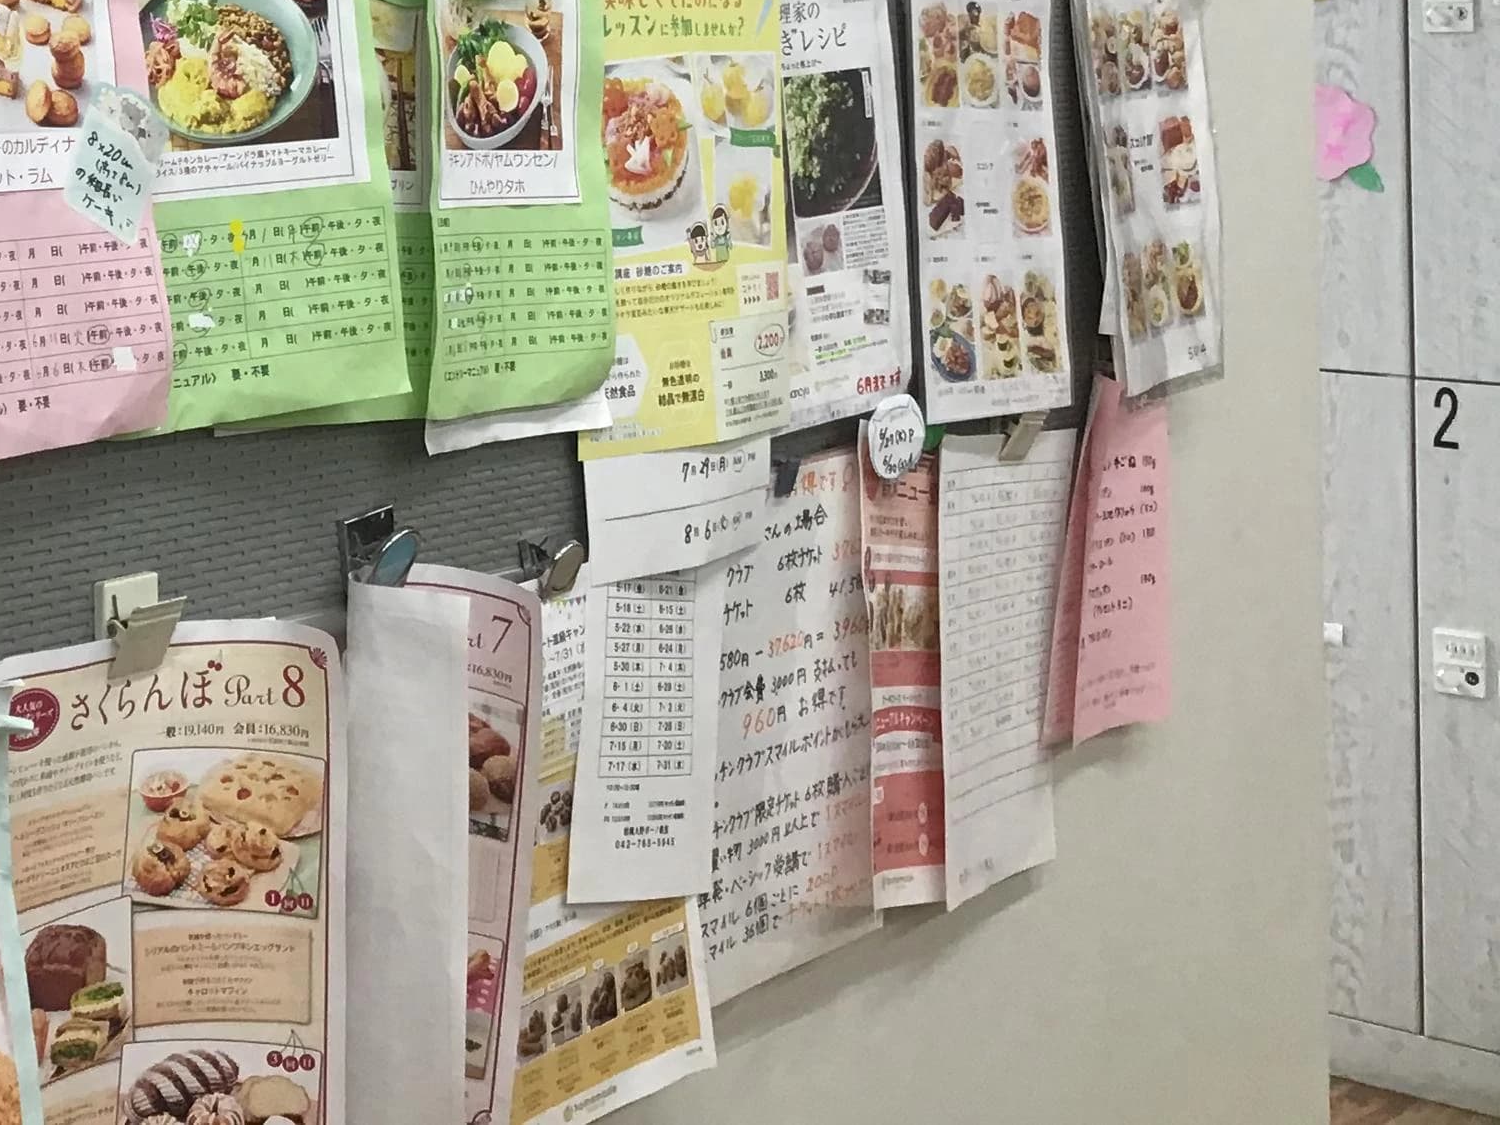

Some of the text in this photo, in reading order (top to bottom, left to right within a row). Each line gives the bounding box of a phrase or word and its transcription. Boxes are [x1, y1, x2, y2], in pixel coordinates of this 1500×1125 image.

[1433, 387, 1460, 450] 2
[491, 615, 514, 654] 7
[69, 664, 307, 733] さくらんぼ Part 8
